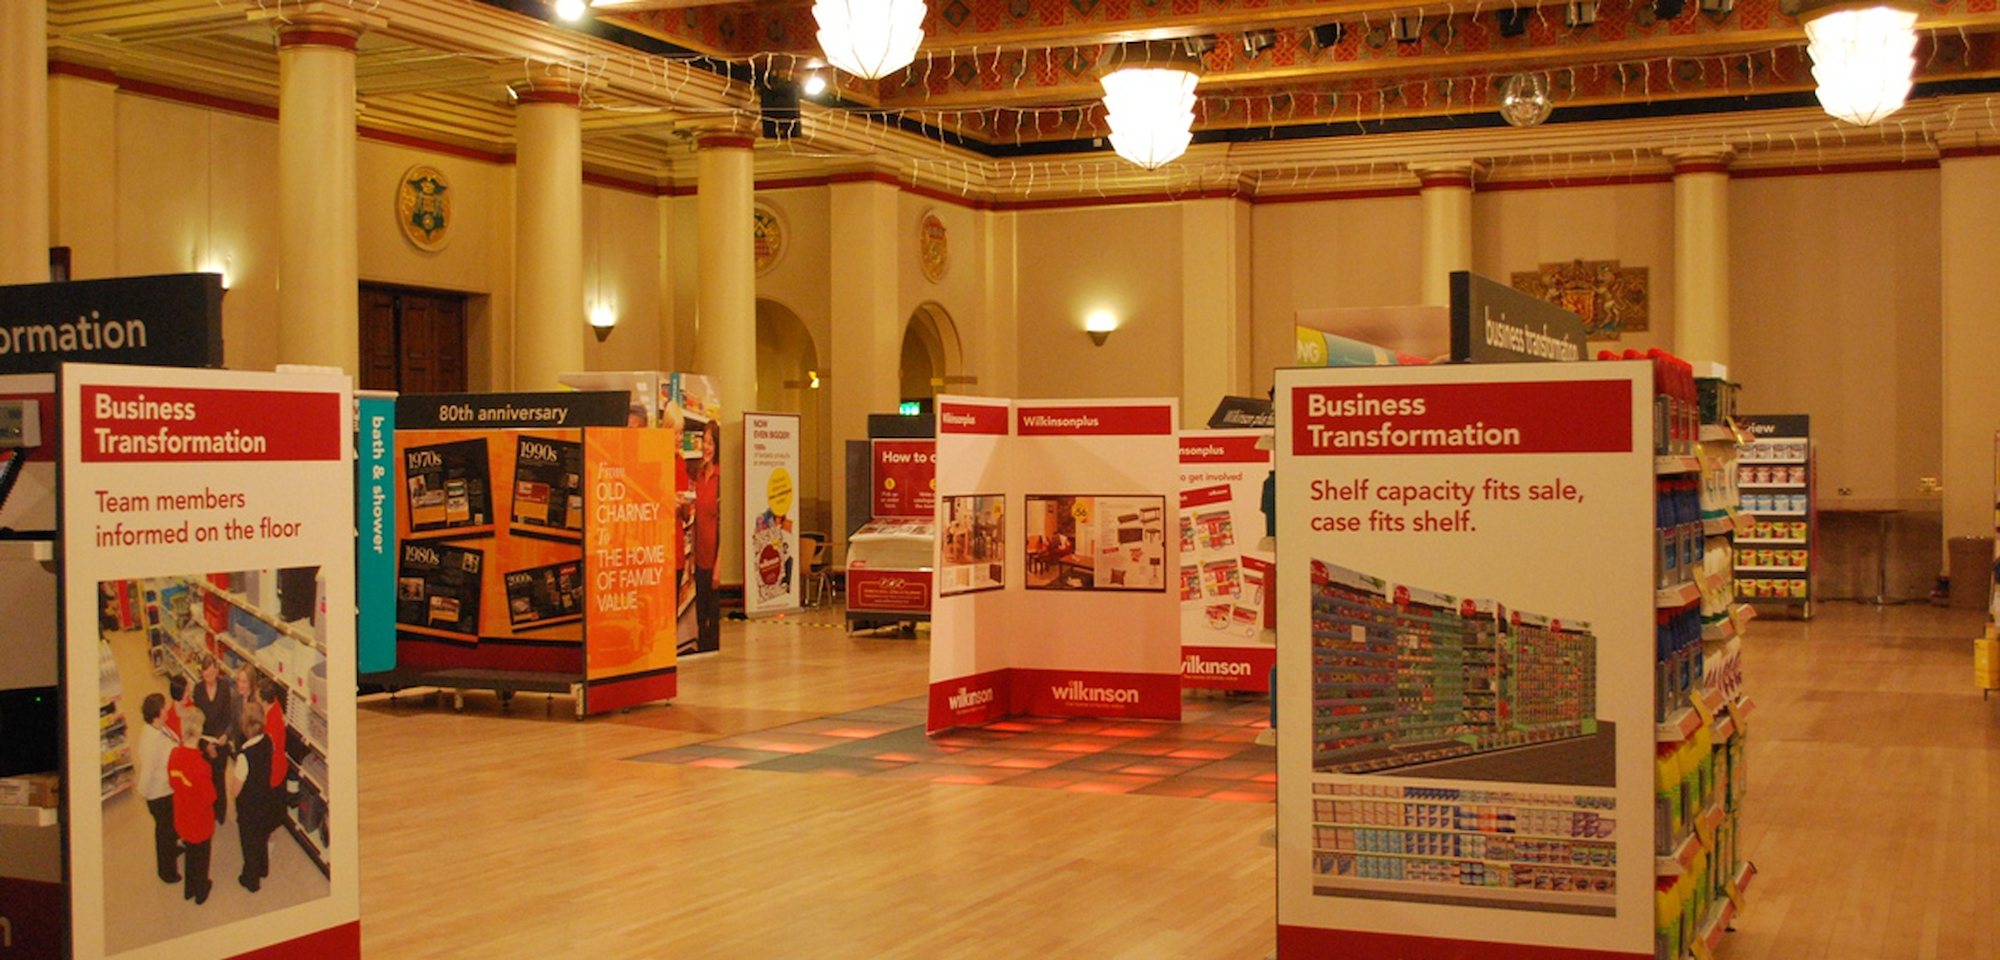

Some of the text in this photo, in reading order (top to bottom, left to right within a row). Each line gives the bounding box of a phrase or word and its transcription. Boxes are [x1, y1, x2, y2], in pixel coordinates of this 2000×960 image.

[0, 310, 147, 354] ormation
[1485, 306, 1578, 362] business transformation
[95, 393, 196, 420] Business
[439, 403, 569, 424] 80th anniversary
[1308, 393, 1426, 417] Business
[1023, 415, 1099, 429] Wilkinsonplus
[95, 427, 267, 454] Transformation
[1308, 422, 1521, 448] Transformation
[408, 450, 442, 469] 1970s
[520, 441, 558, 461] 1990s
[882, 451, 911, 463] How
[913, 452, 927, 463] to
[598, 461, 625, 480] From
[1189, 474, 1203, 484] get
[1206, 472, 1243, 481] involved
[372, 415, 385, 554] bath & shower
[596, 481, 626, 502] OLD
[1310, 478, 1584, 506] Shelf capacity fits sale,
[95, 487, 246, 513] Team members
[596, 502, 660, 524] CHARNEY
[1310, 510, 1477, 532] case fits shelf.
[96, 516, 302, 548] informed on the floor
[405, 545, 440, 566] 1980s
[597, 545, 665, 568] THE HOME
[597, 567, 663, 591] OF FAMILY
[597, 591, 638, 612] VALUE
[949, 686, 994, 710] wilkinson
[1052, 680, 1139, 702] wilkinson
